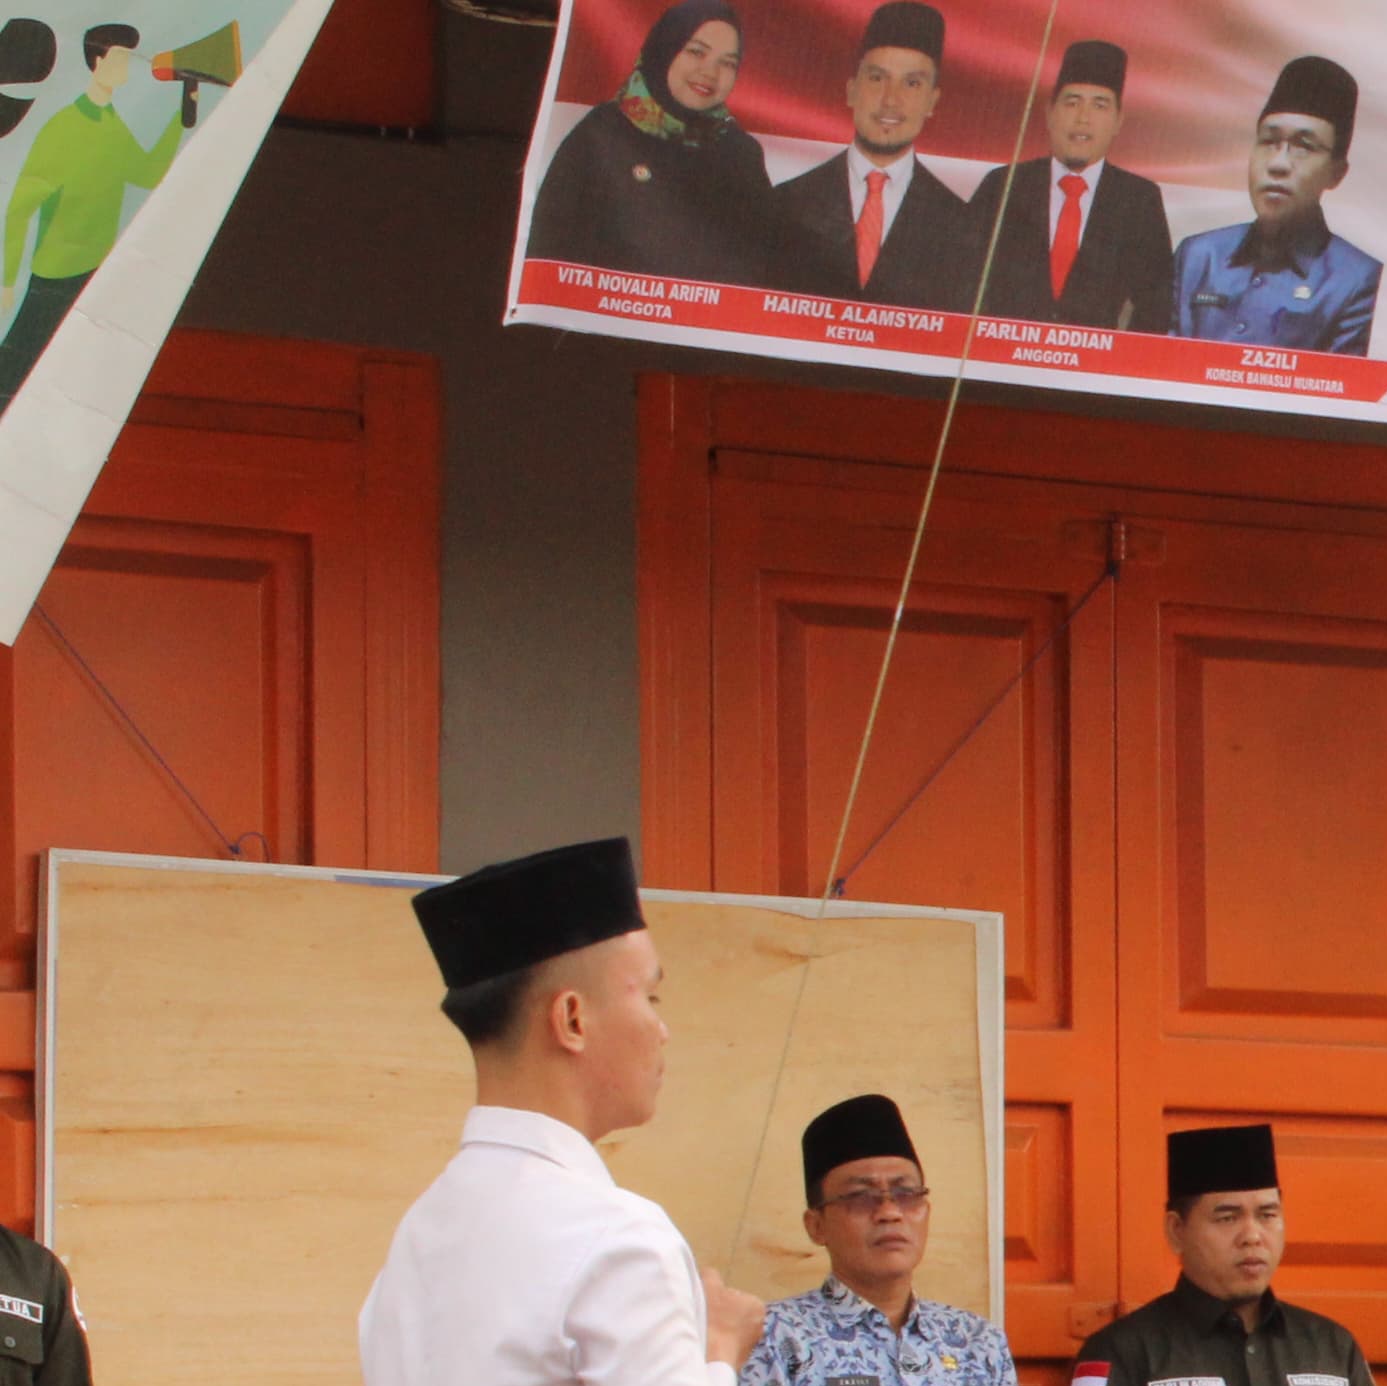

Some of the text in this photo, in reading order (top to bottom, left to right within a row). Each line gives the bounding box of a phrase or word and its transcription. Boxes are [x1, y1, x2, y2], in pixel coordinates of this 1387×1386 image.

[557, 266, 721, 305] VITA NOVALIA ARIFIN
[598, 296, 673, 319] ANGGOTA
[762, 294, 945, 333] HAIRUL ALAMSYAH
[825, 324, 876, 344] KETUA
[976, 321, 1114, 351] FARLIN ADDIAN
[1011, 347, 1080, 367] ANGGOTA
[1240, 348, 1299, 371] ZAZILI
[1205, 367, 1246, 384] KORSEK
